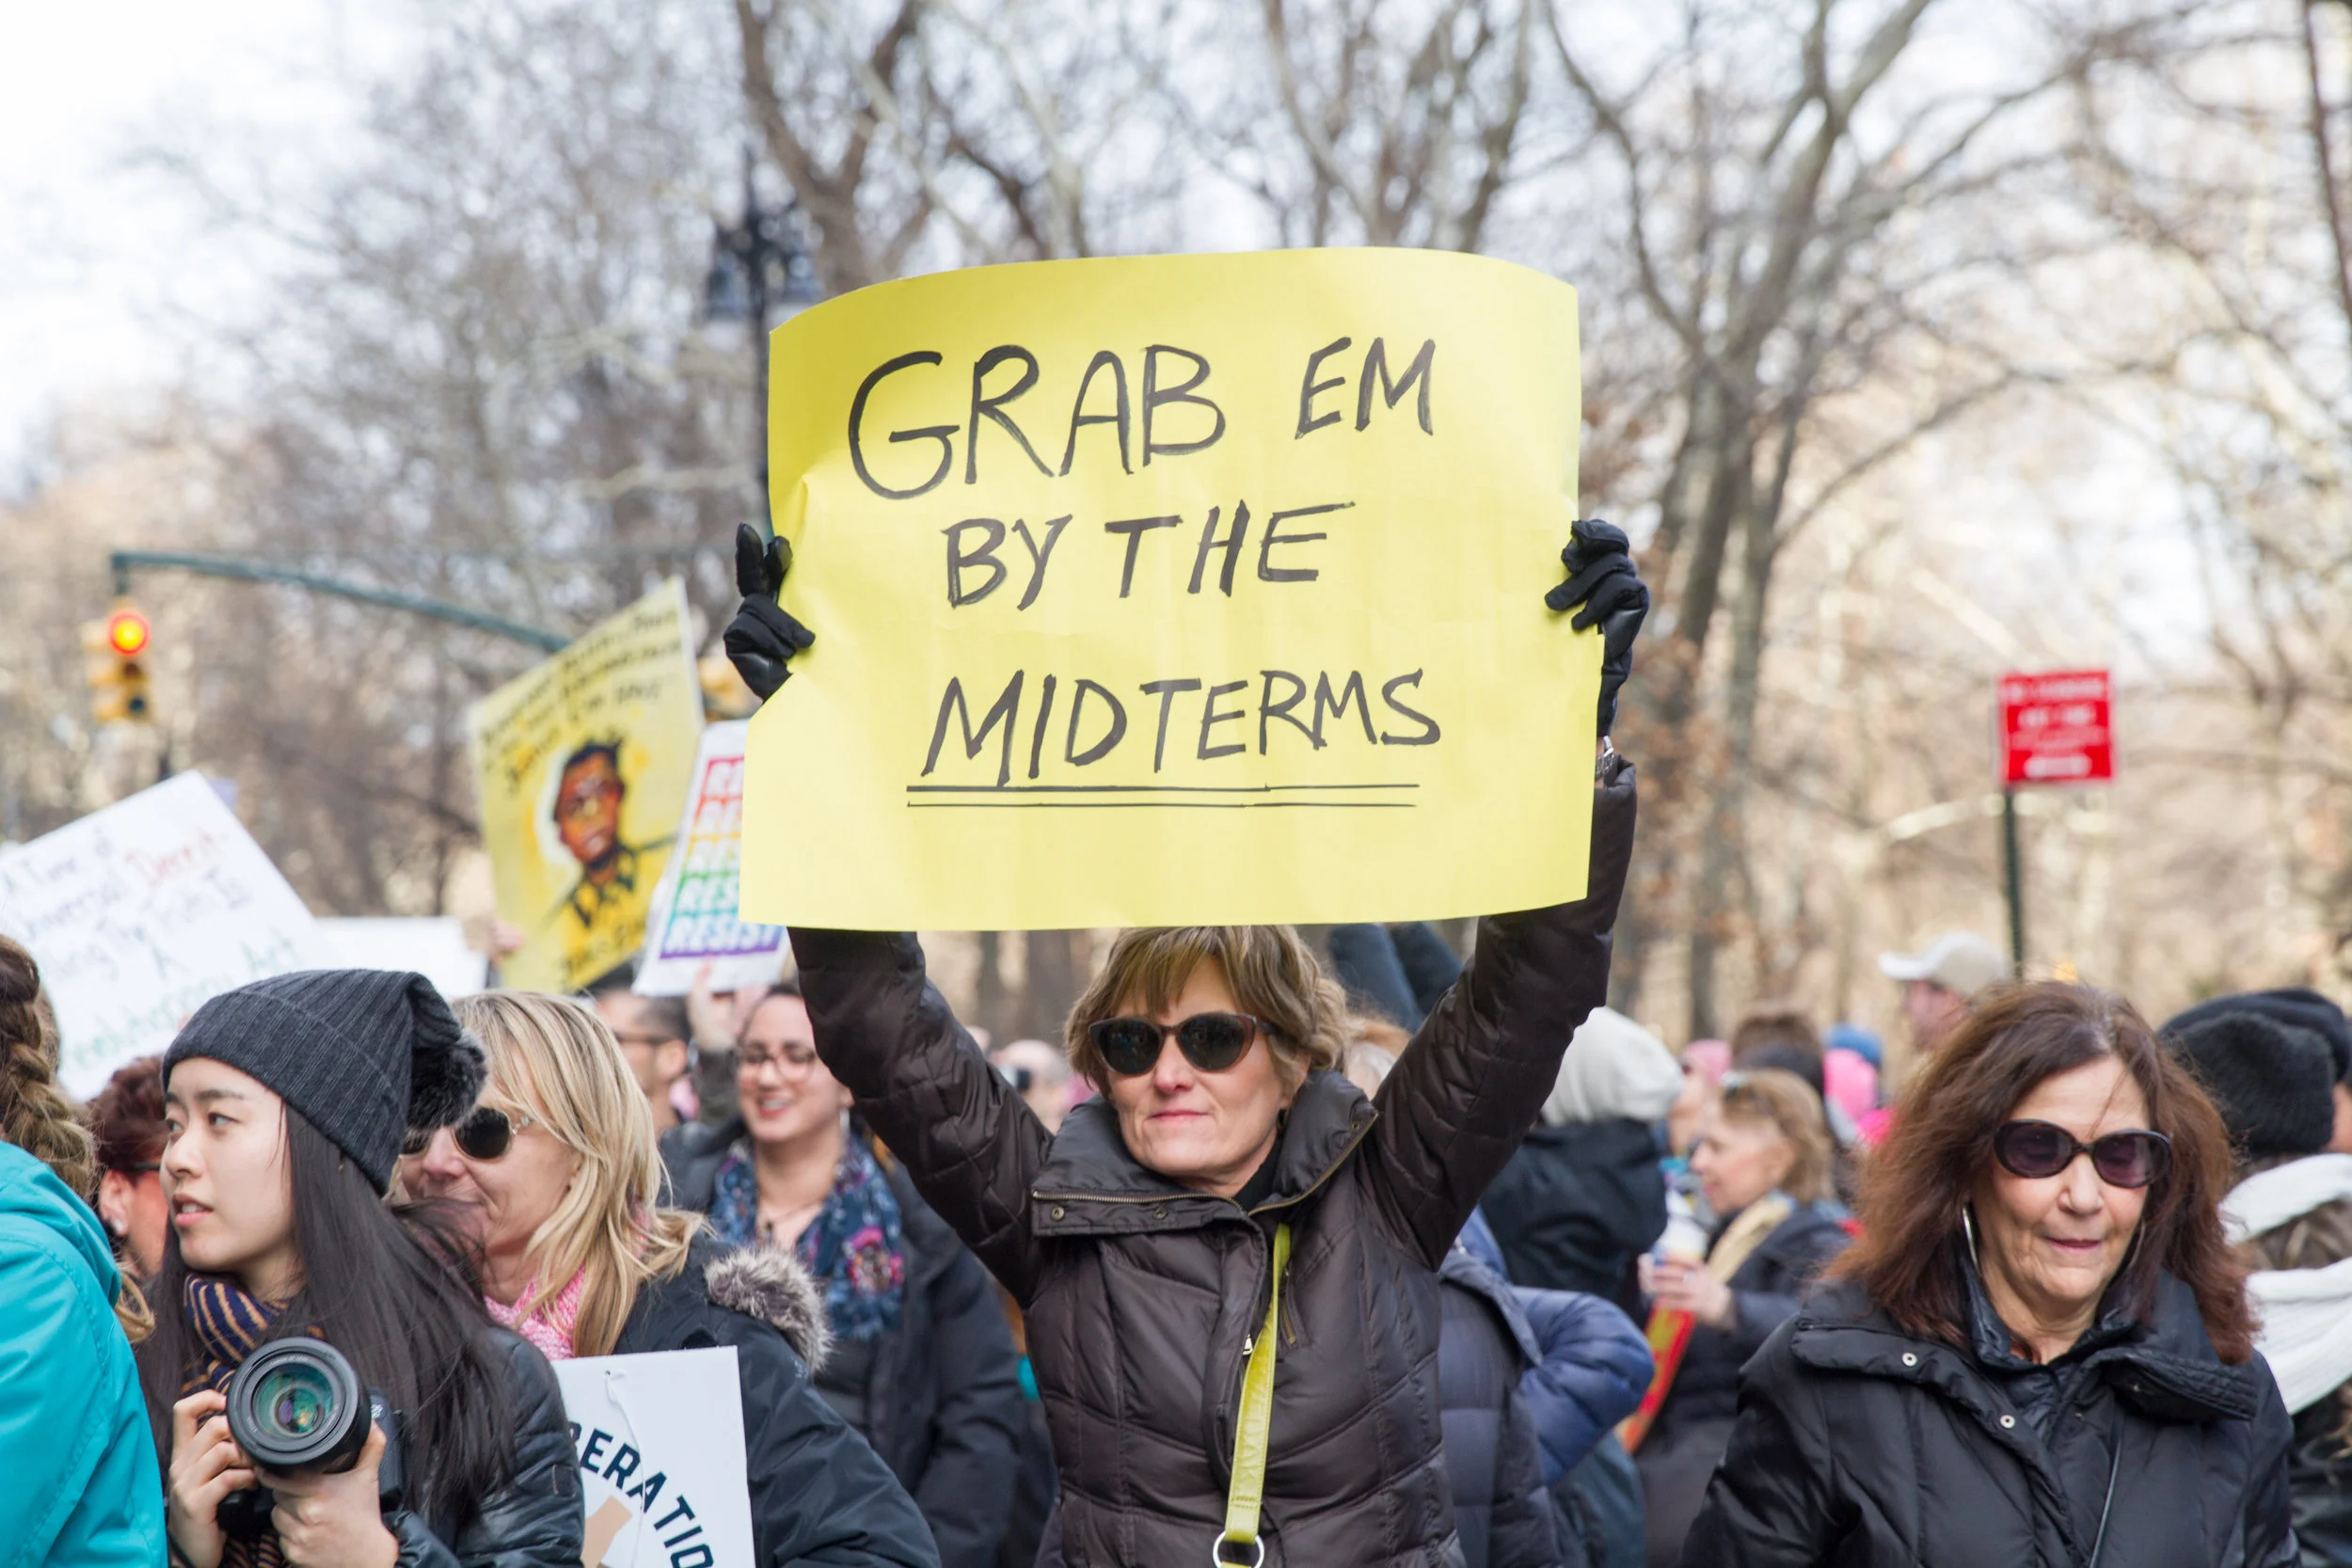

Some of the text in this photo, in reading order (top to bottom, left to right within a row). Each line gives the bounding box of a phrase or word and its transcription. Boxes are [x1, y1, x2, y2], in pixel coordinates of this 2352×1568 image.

[848, 336, 1437, 500] GRAB EM
[942, 499, 1357, 611] BY THE
[918, 667, 1442, 786] MIDTERMS
